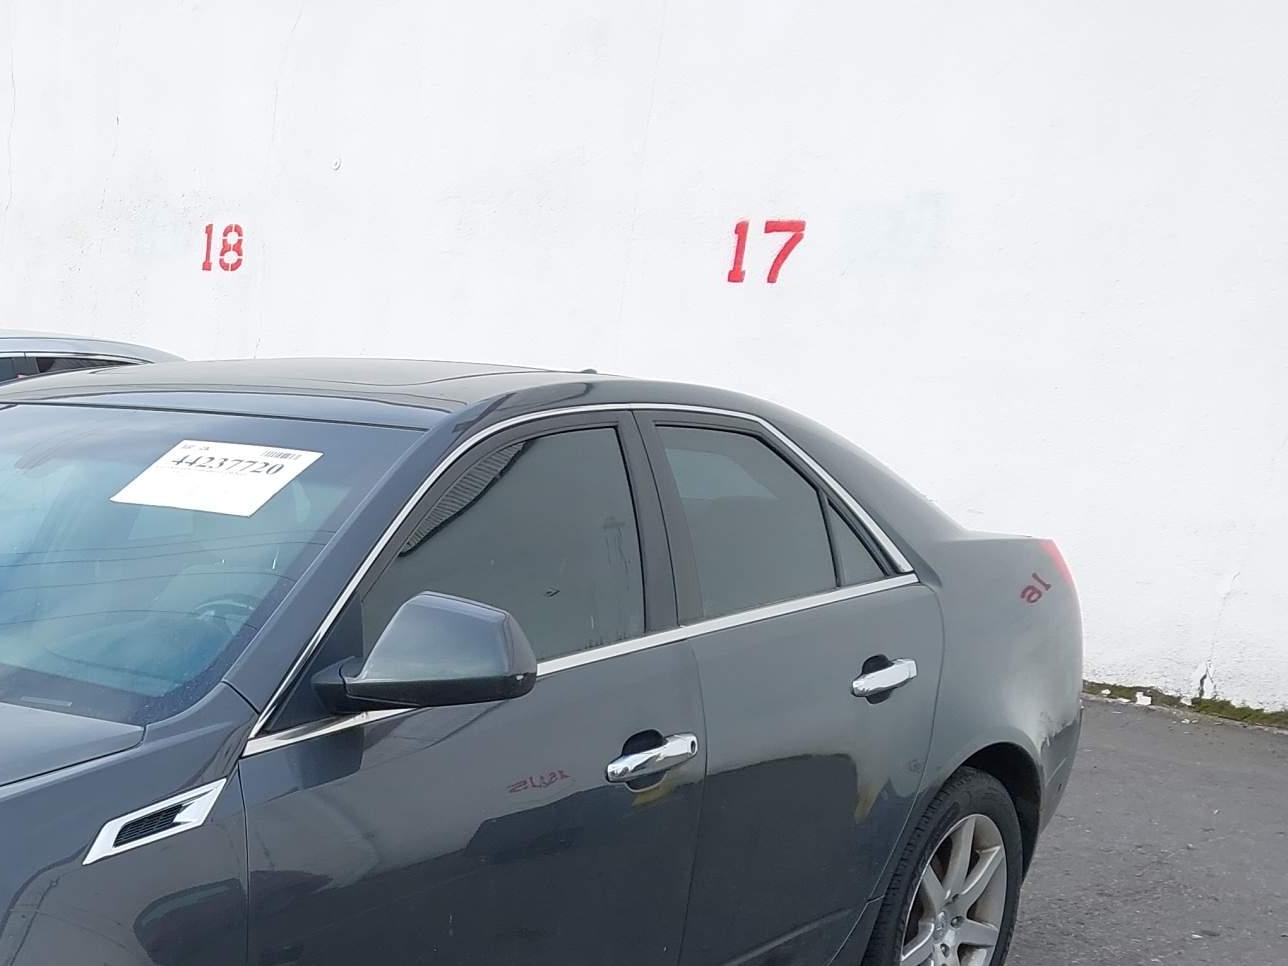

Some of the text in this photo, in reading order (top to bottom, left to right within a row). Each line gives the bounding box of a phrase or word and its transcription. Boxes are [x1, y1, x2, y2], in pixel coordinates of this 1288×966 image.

[202, 223, 243, 272] 18
[726, 219, 807, 284] 17
[171, 454, 285, 475] 44237720
